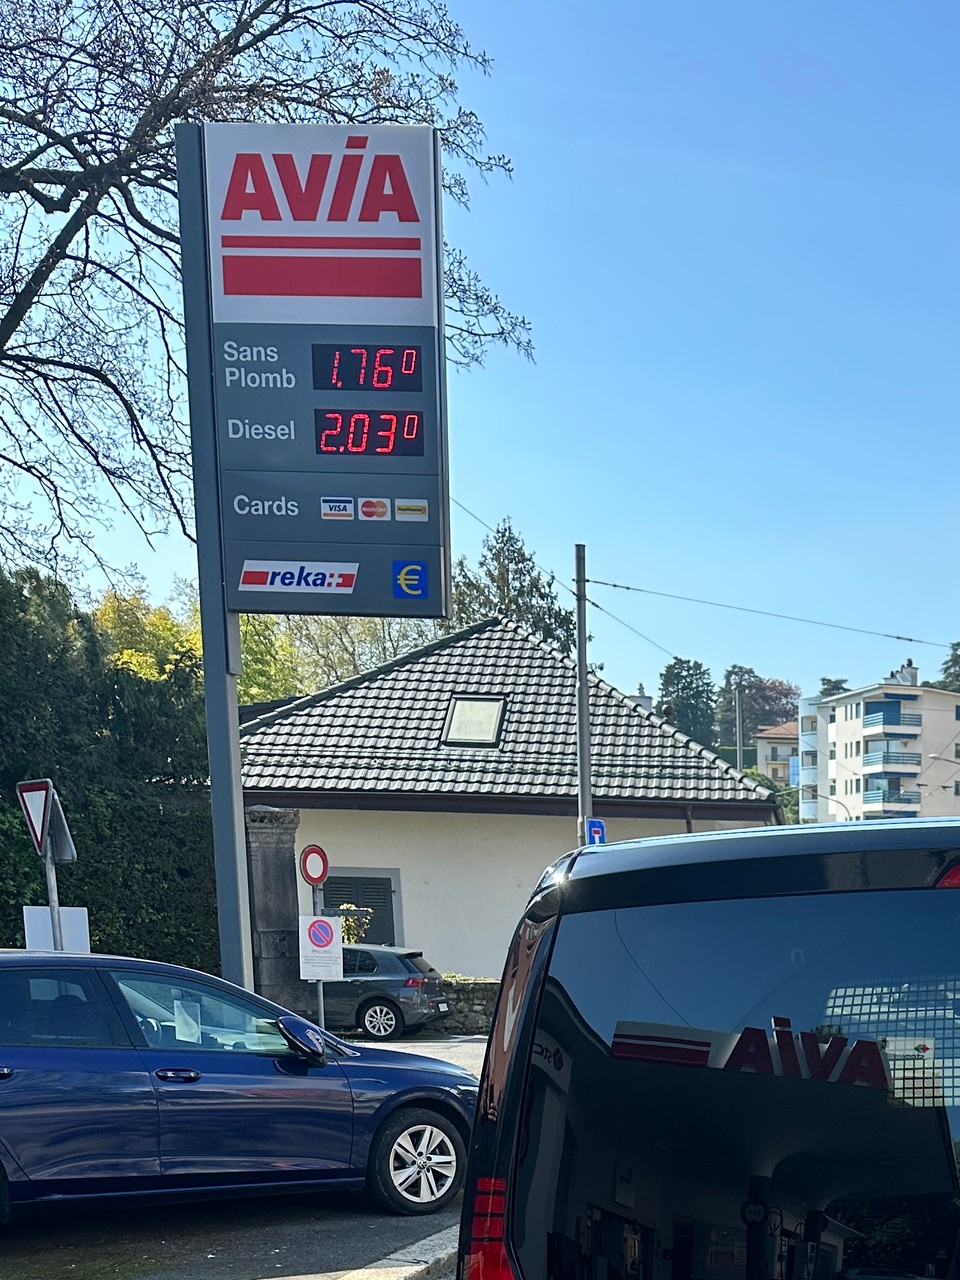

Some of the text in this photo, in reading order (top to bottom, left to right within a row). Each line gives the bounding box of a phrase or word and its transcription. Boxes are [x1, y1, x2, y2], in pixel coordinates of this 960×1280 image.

[223, 341, 278, 363] Sans
[225, 367, 296, 389] Plomb
[228, 419, 295, 441] Diesel
[233, 495, 299, 517] Cards
[328, 504, 348, 512] VISA
